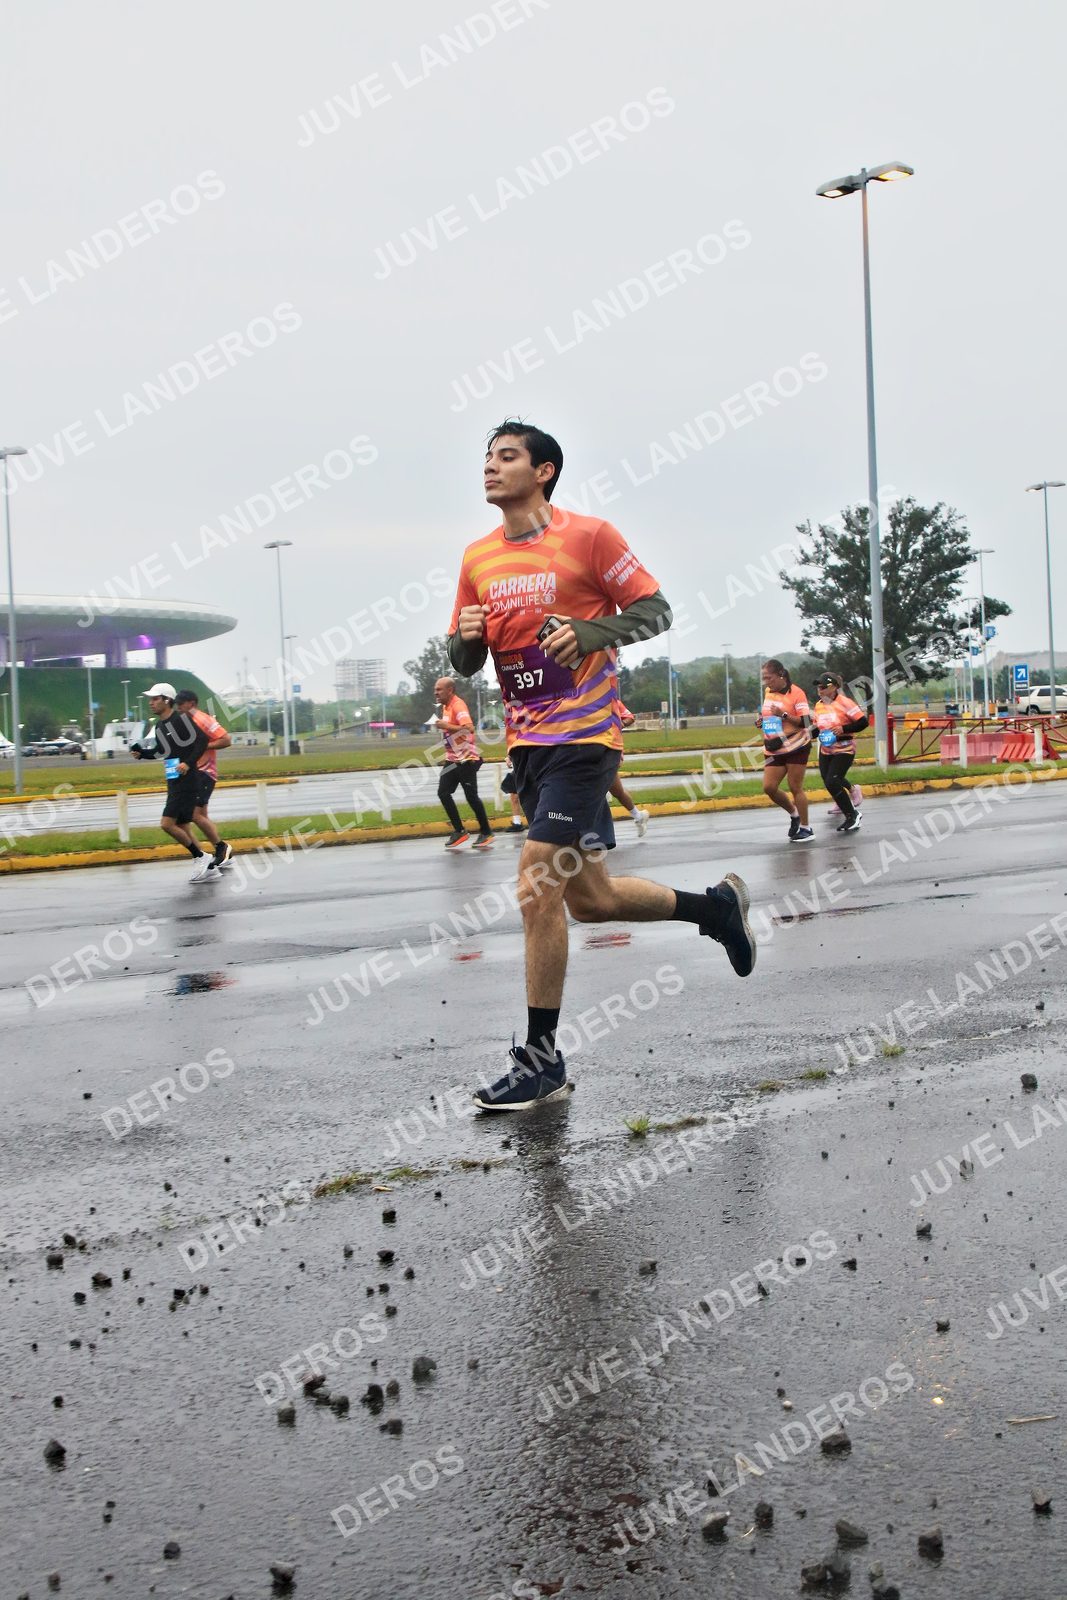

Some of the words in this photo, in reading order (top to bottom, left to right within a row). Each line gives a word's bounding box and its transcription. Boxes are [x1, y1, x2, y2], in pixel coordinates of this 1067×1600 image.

[489, 571, 557, 600] CARRERA
[492, 593, 540, 613] OMNILIFE
[513, 668, 545, 690] 397
[547, 811, 573, 822] Wilson
